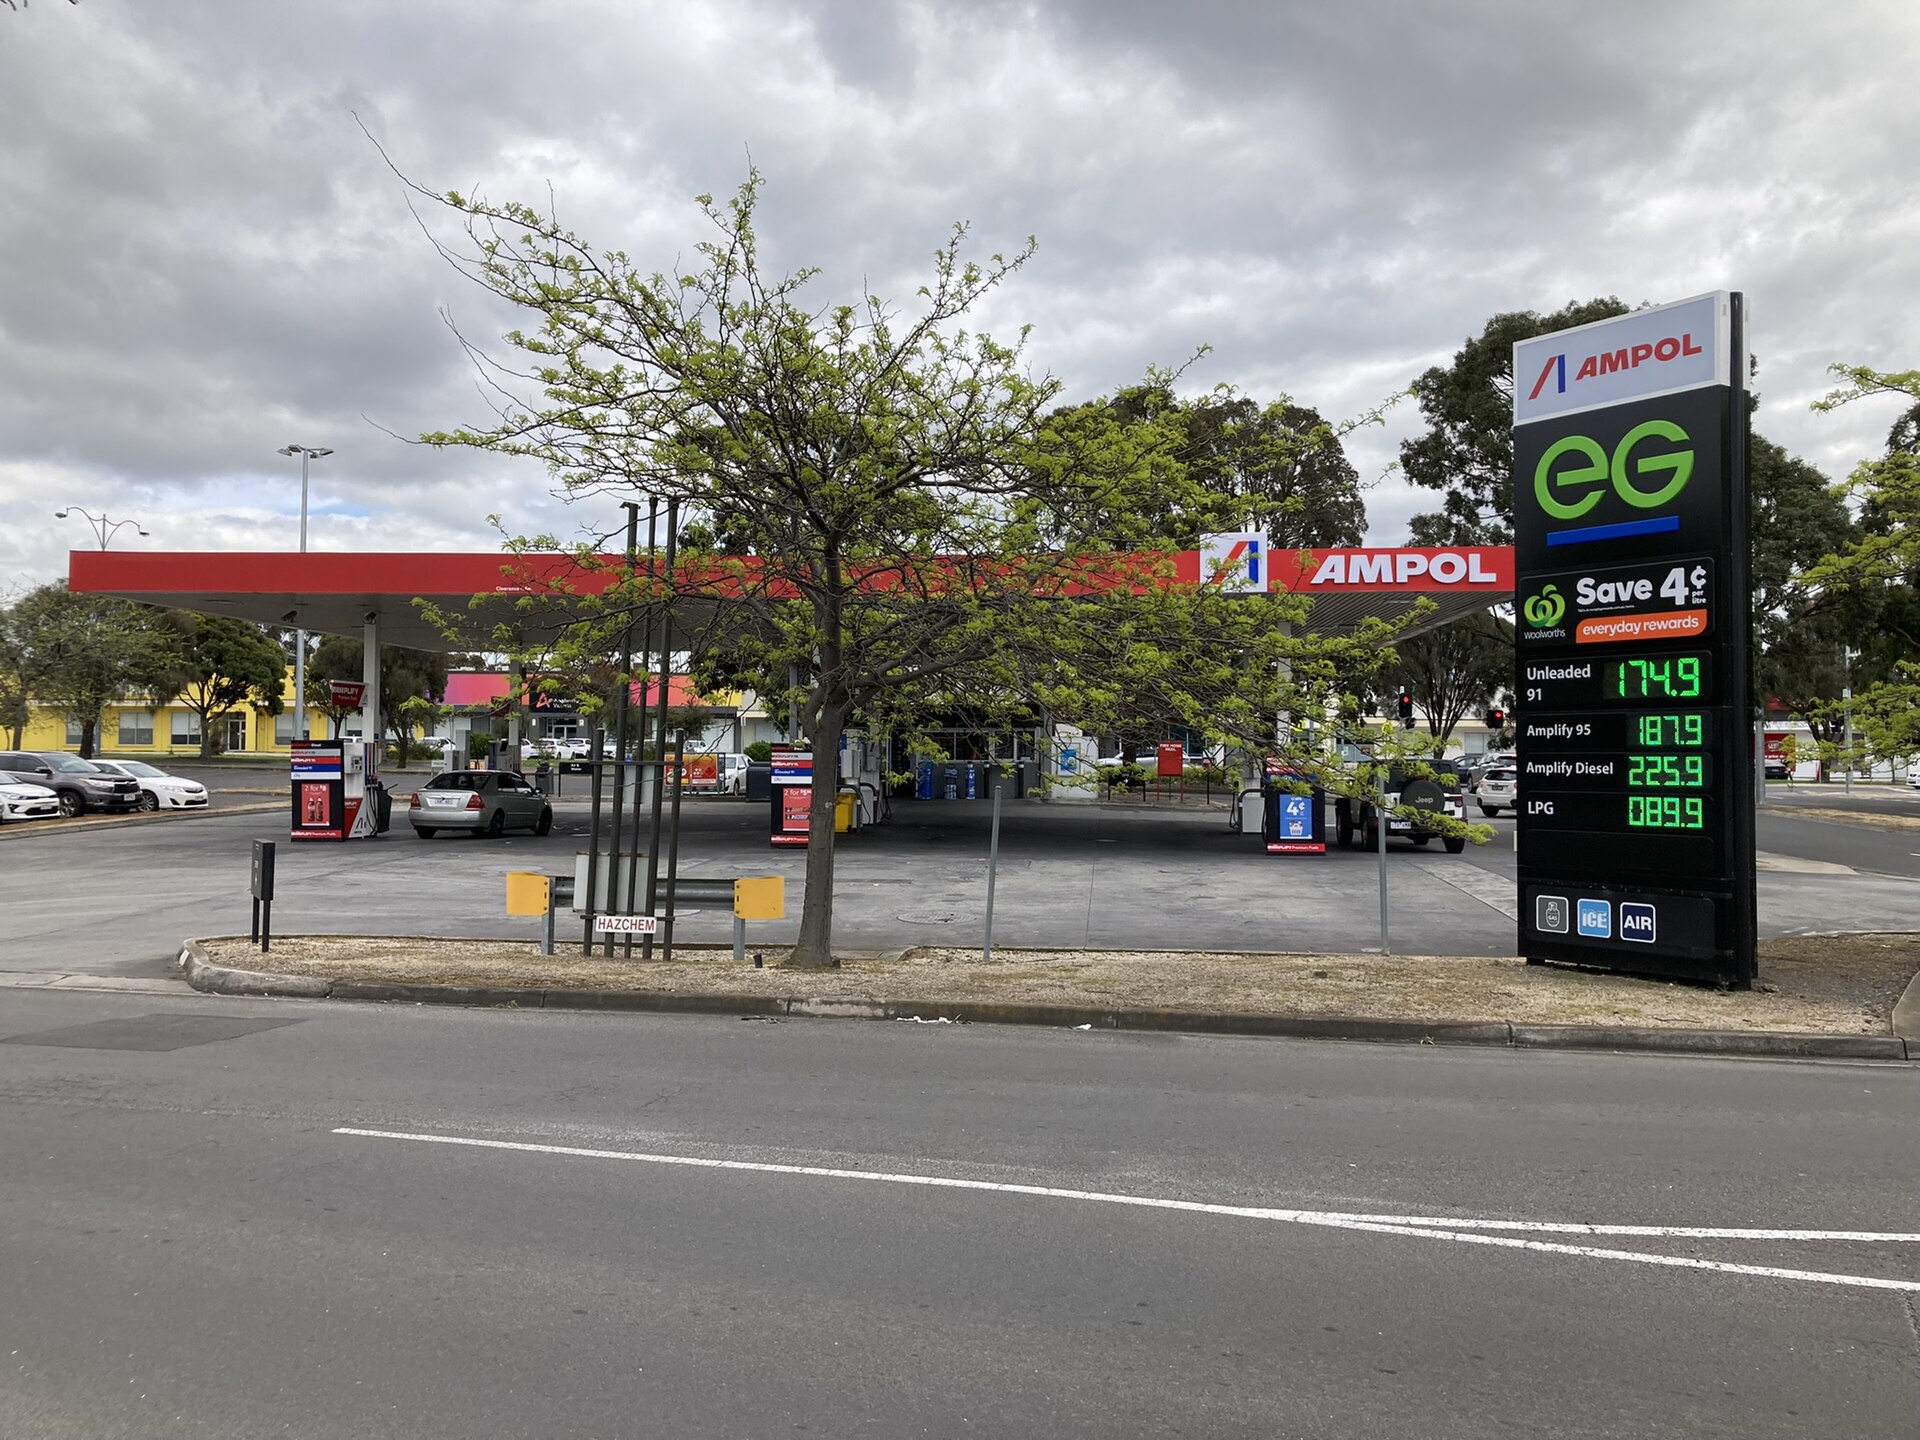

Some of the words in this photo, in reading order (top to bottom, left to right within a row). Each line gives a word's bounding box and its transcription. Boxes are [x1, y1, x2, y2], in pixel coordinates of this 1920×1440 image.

[1575, 333, 1703, 381] AMPOL
[1311, 553, 1497, 585] AMPOL
[1576, 577, 1653, 606] Save
[1691, 590, 1704, 598] per
[1691, 597, 1707, 605] litre
[1524, 628, 1566, 640] woolworths
[1582, 621, 1642, 637] everyday
[1643, 615, 1700, 631] rewards
[1526, 664, 1591, 681] Unleaded
[1618, 657, 1700, 697] 174.9
[1526, 688, 1543, 701] 91
[1526, 724, 1573, 739] Amplify
[1575, 724, 1591, 737] 95
[1639, 714, 1702, 745] 187.9
[1526, 762, 1573, 777] Amplify
[1575, 761, 1614, 775] Diesel
[1628, 755, 1703, 786] 225.9
[1415, 796, 1434, 804] Jeep
[1527, 801, 1555, 815] LPG
[1628, 796, 1703, 828] 089.9
[598, 918, 655, 931] HAZCHEM
[1581, 909, 1608, 929] ICE
[1623, 914, 1653, 931] AIR
